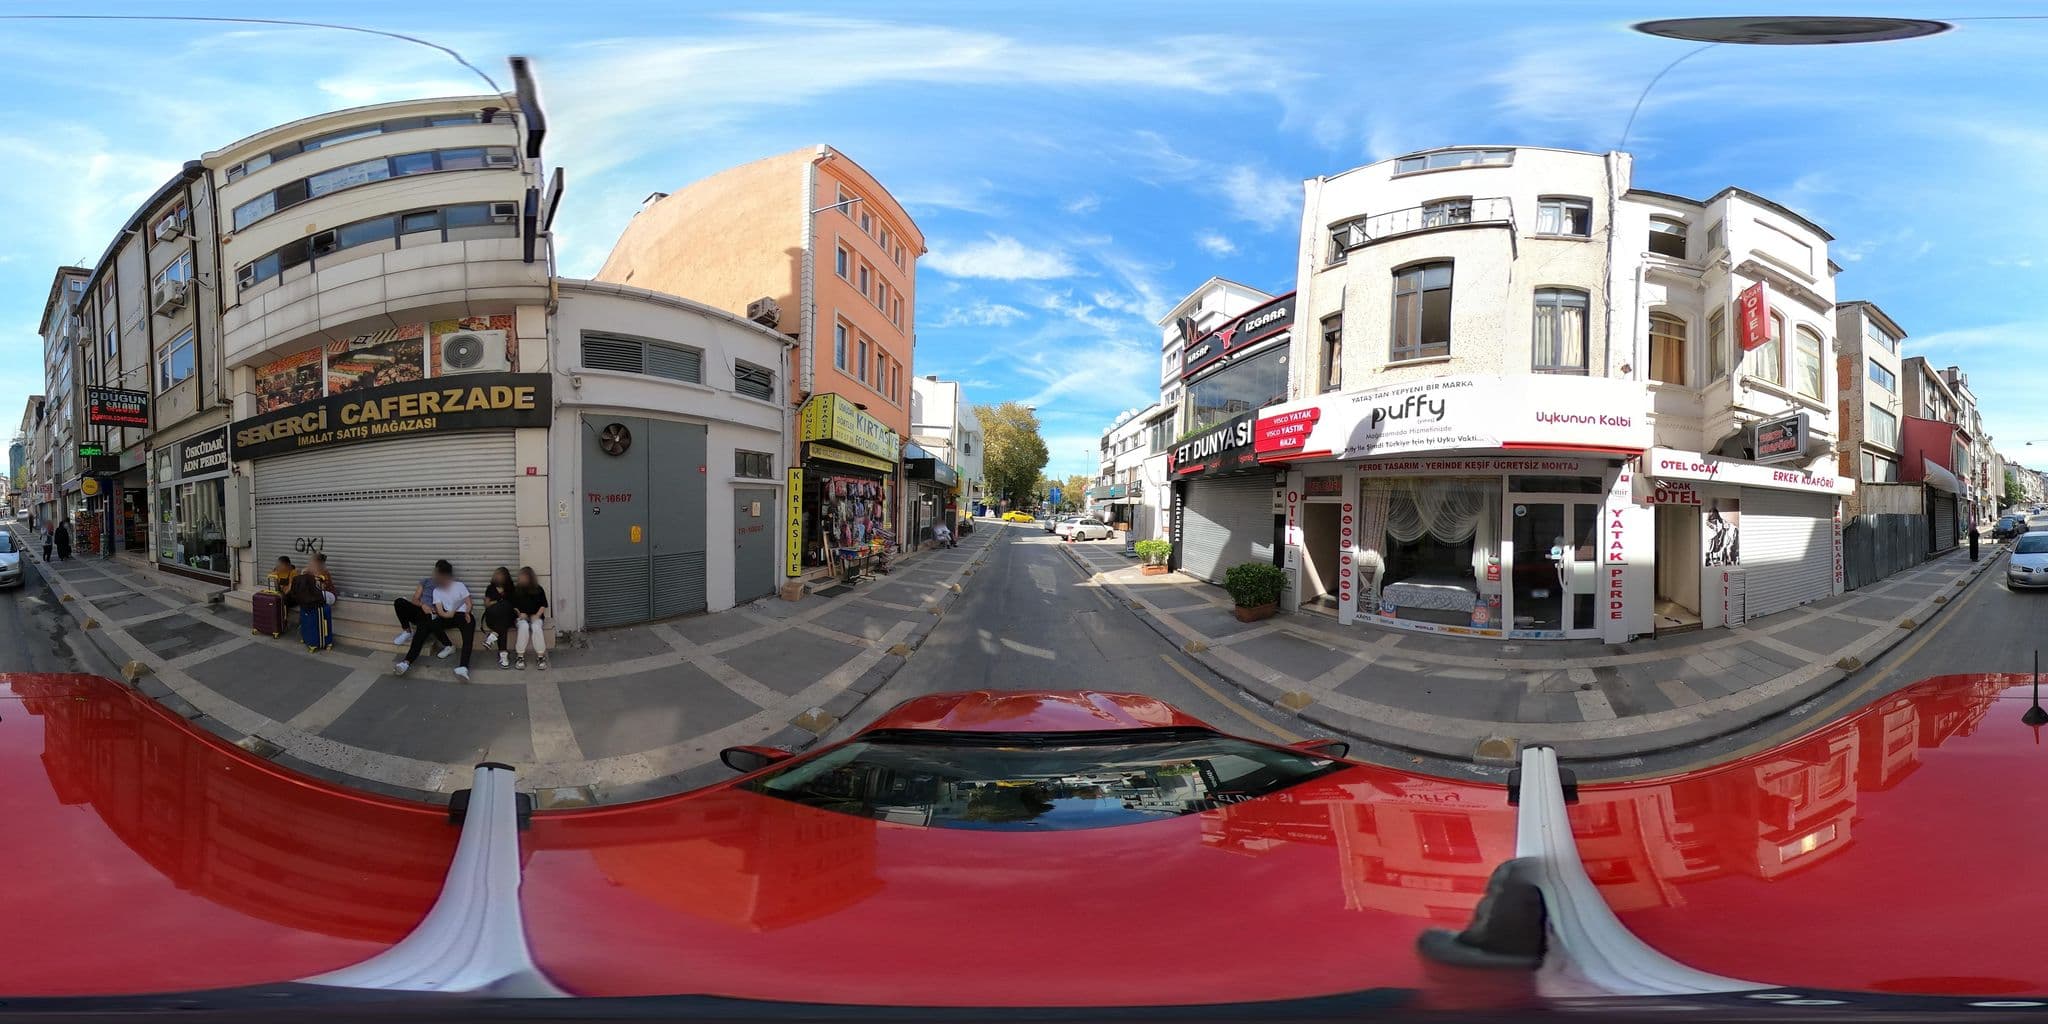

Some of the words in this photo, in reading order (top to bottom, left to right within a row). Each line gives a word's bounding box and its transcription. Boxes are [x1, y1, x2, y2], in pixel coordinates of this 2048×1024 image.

[1245, 308, 1287, 332] IZGARA
[1747, 297, 1759, 342] OTEL
[1187, 344, 1209, 364] KASAP
[1442, 380, 1474, 389] MARKA
[340, 386, 536, 425] CAFERZADE
[1290, 410, 1312, 421] YATAK
[1371, 394, 1444, 430] puffy
[1536, 411, 1596, 425] Uykunun
[1600, 415, 1631, 427] Kalbi
[298, 431, 334, 447] İMALAT
[337, 427, 369, 438] SATIŞ
[372, 417, 437, 435] MAĞAZASI
[1281, 424, 1304, 435] YASTIK
[185, 438, 224, 458] ÜSKÜDAR
[1437, 436, 1456, 445] Uyku
[183, 460, 199, 472] ADN
[200, 452, 227, 469] PERDE
[1178, 443, 1191, 463] ET
[1385, 462, 1419, 470] TASARIM
[1425, 460, 1463, 470] YERİNDE
[1464, 461, 1490, 471] KEŞİF
[1541, 461, 1579, 471] MONTAJ
[1660, 460, 1688, 471] OTEL
[1691, 463, 1719, 474] OCAK
[1773, 471, 1799, 484] ERKEK
[1655, 488, 1701, 504] OTEL
[792, 471, 800, 572] KIRTASİYE
[1288, 491, 1298, 546] OTEL
[1610, 509, 1624, 561] YATAK
[1610, 569, 1624, 620] PERDE
